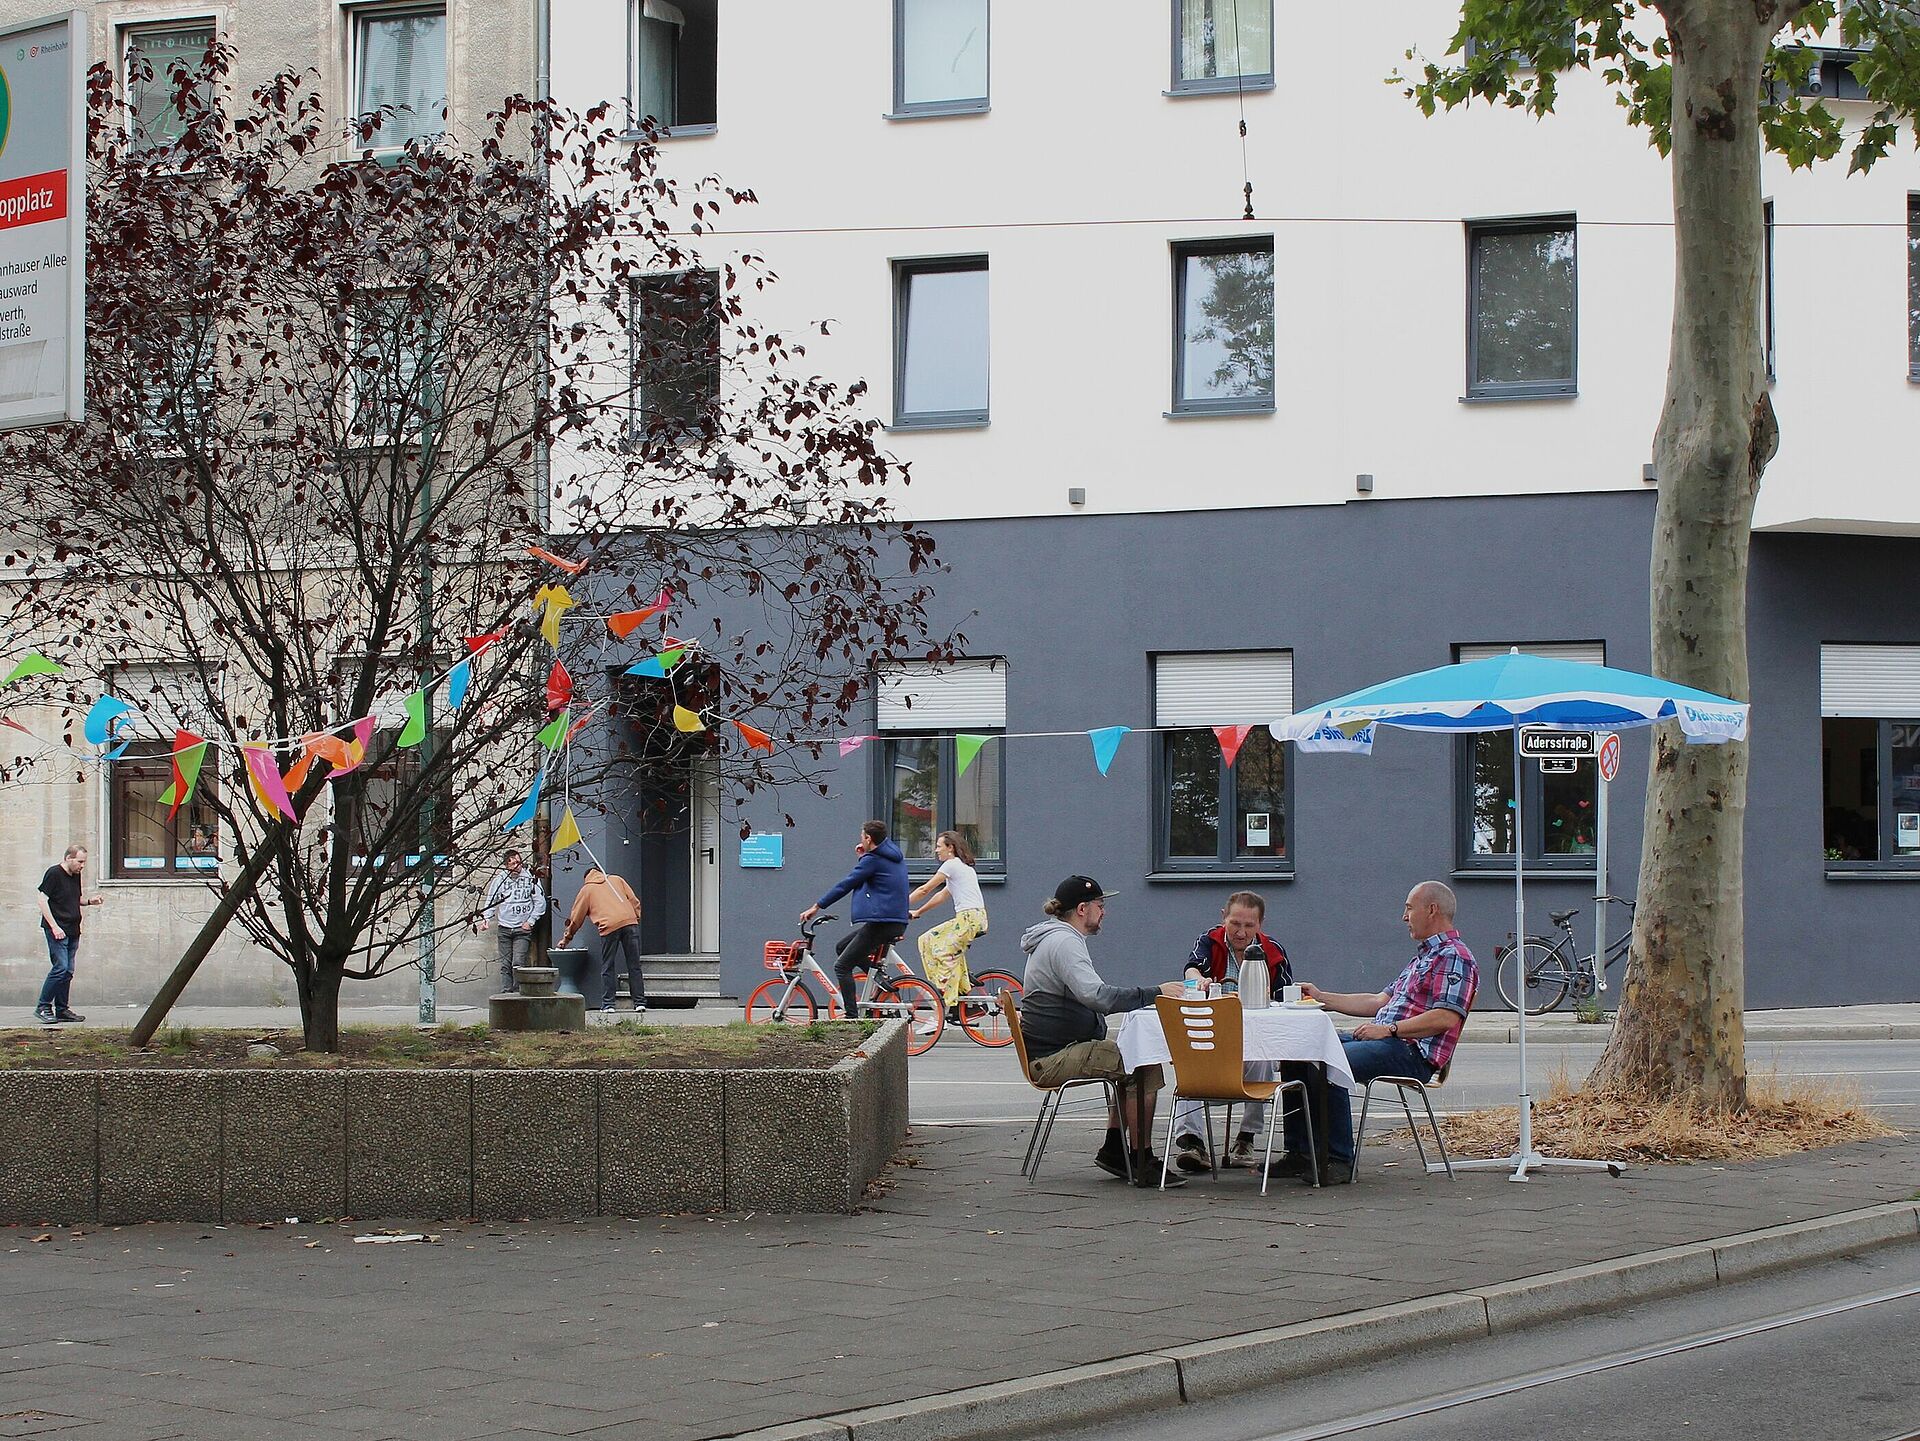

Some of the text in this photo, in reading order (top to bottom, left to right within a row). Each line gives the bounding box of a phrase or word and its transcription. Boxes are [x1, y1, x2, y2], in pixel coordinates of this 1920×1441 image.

[0, 187, 53, 222] opplatz
[43, 253, 67, 269] Allee
[1527, 736, 1588, 750] Adersstraße
